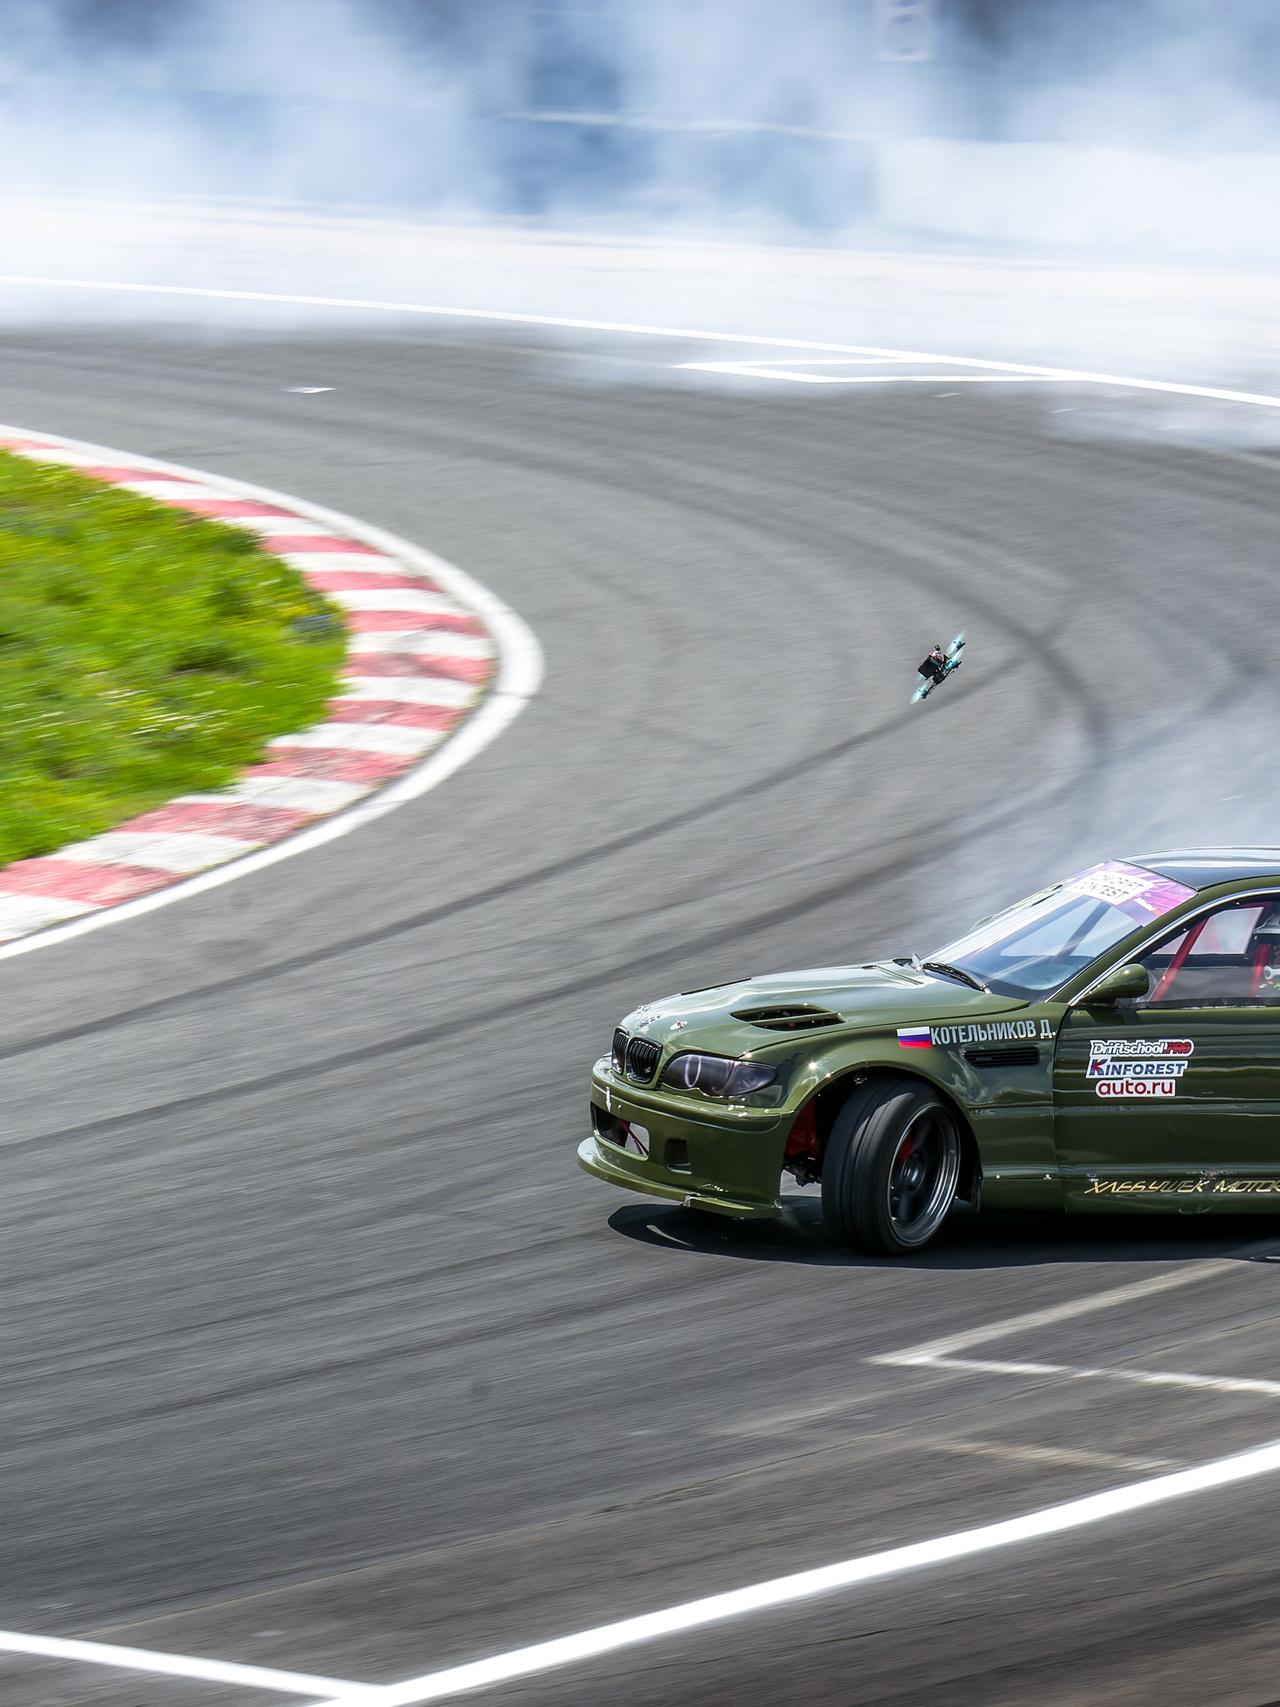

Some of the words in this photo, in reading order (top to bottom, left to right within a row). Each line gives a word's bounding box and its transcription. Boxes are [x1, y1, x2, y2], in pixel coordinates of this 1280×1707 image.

[930, 1020, 1037, 1045] КОТЕЛЬНИКОВ
[1040, 1019, 1056, 1039] Д.
[1088, 1059, 1186, 1076] KINFOREST
[1098, 1080, 1173, 1095] auto.ru
